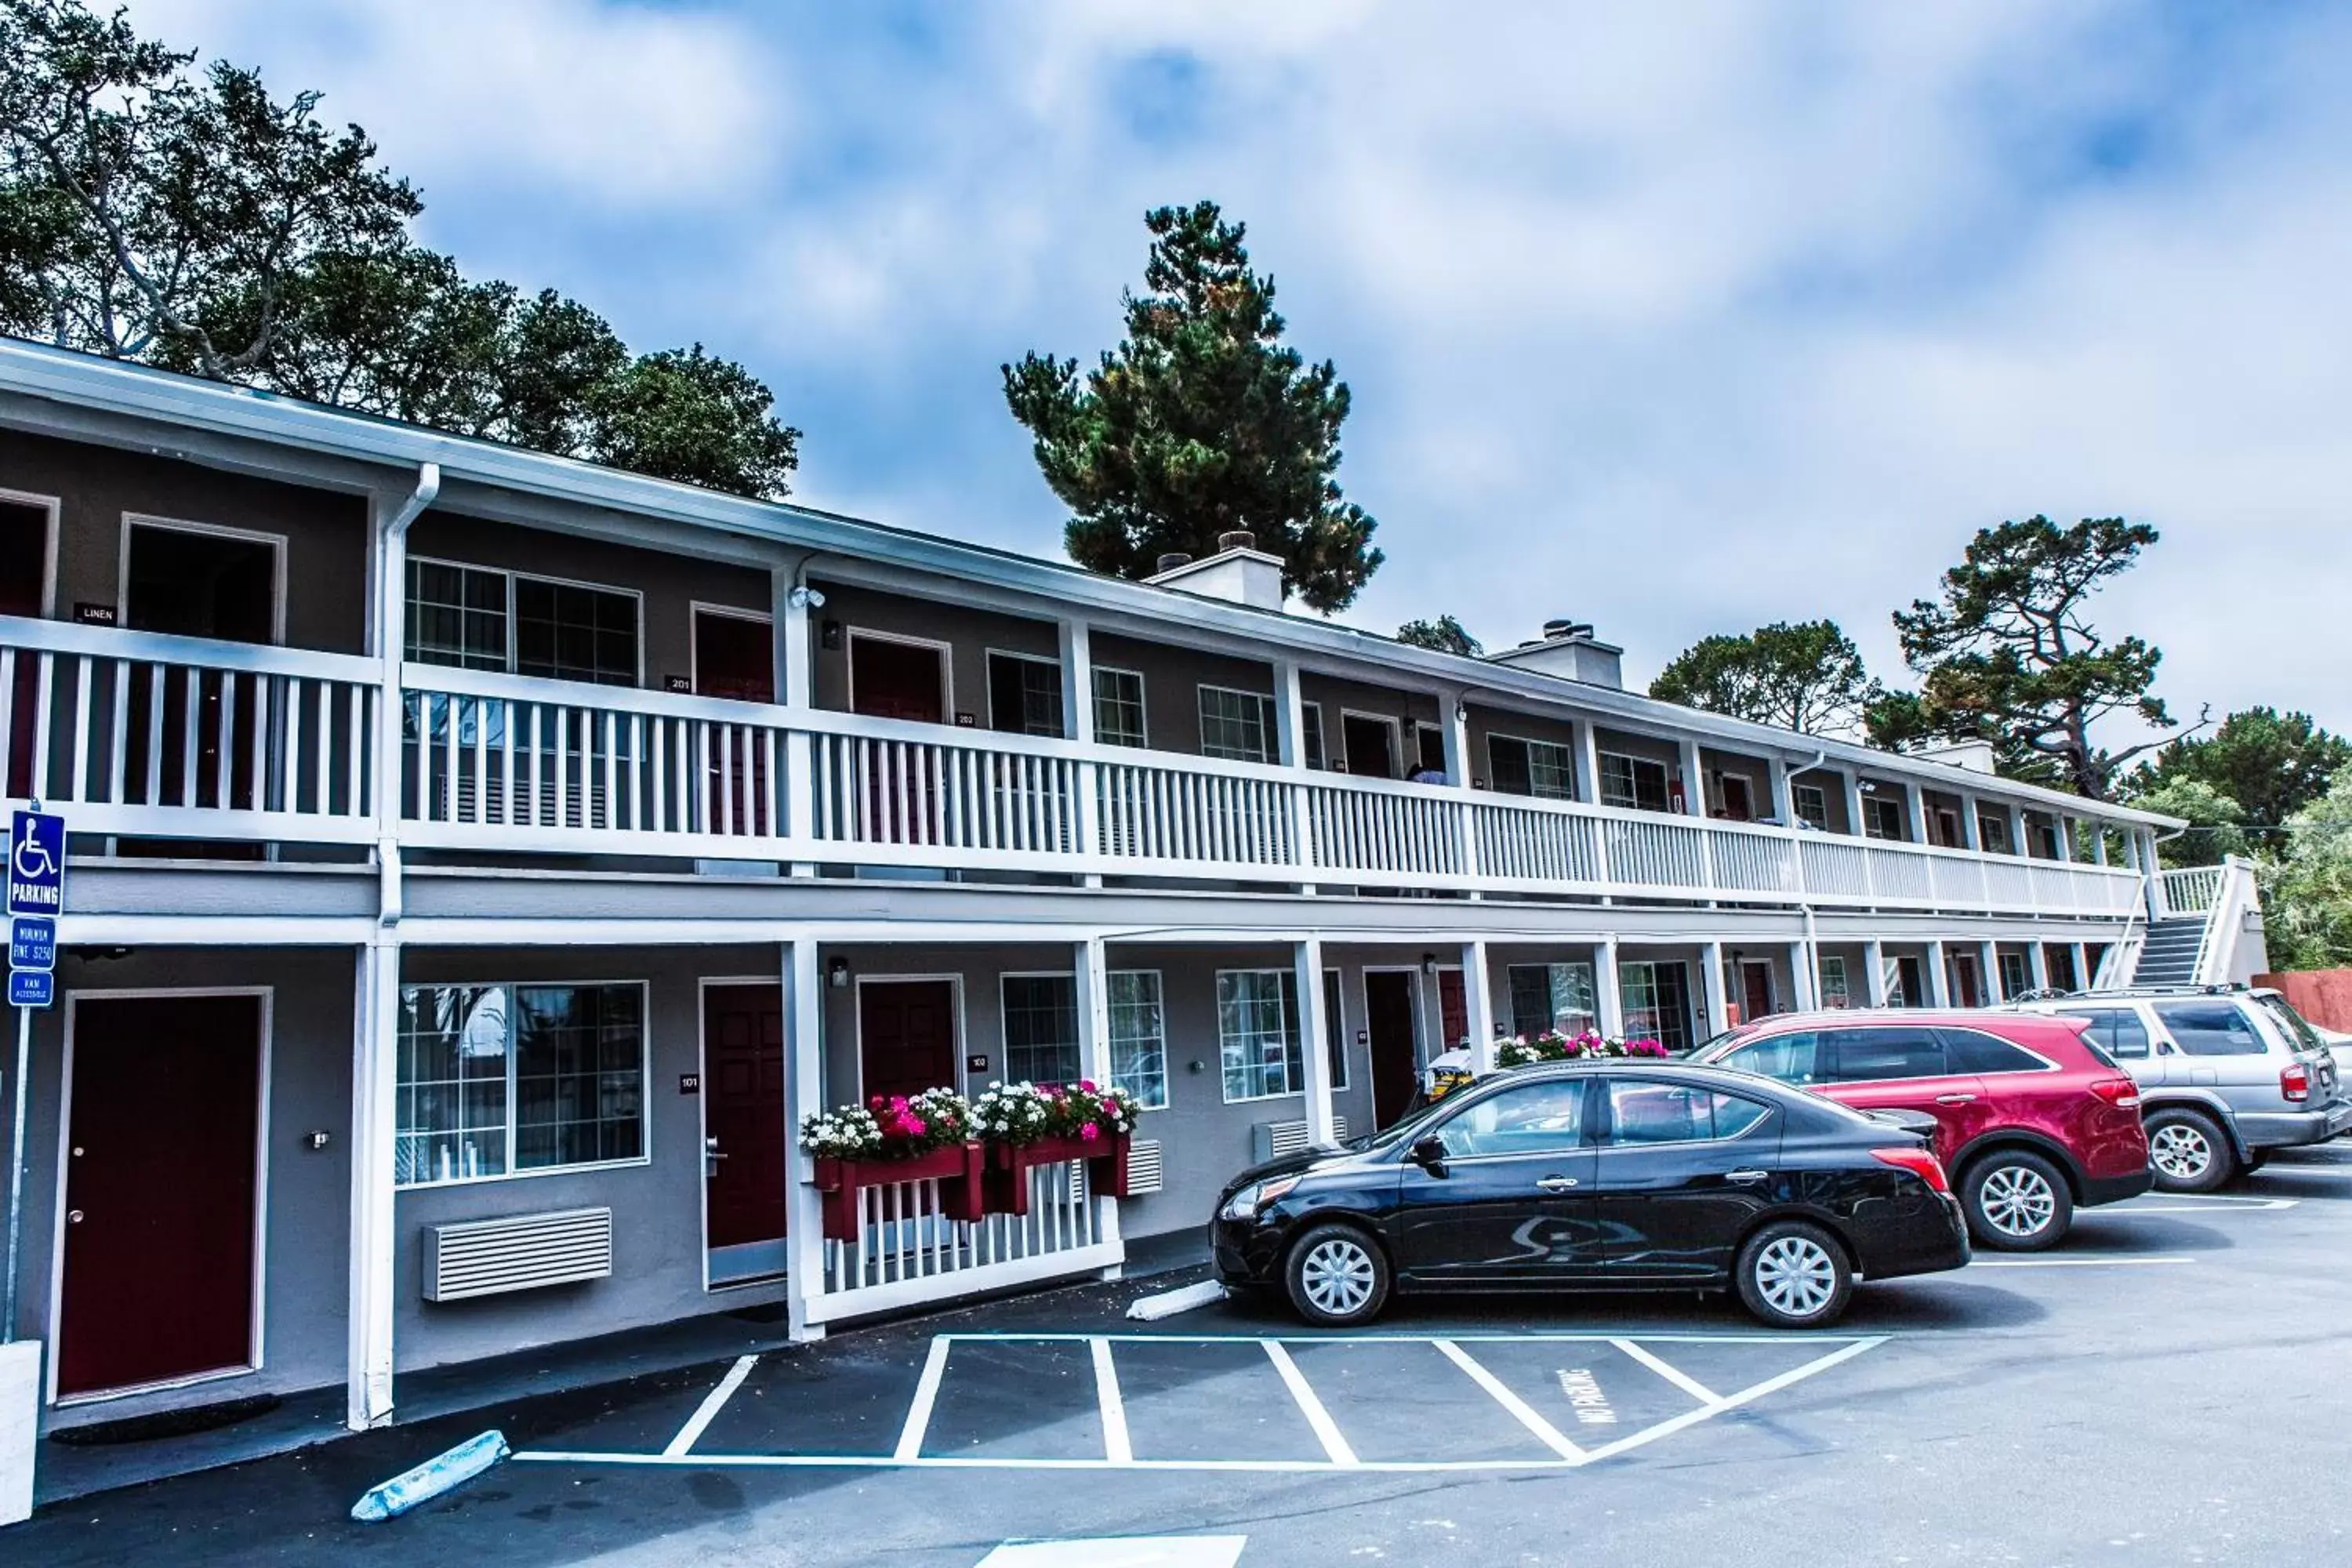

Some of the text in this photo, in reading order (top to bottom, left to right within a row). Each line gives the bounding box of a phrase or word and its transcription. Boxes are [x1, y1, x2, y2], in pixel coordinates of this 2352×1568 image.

[84, 608, 113, 620] LINEN
[672, 678, 689, 689] 201
[12, 882, 59, 906] PARKING
[13, 943, 52, 960] FINE $250
[24, 978, 40, 989] VAN
[682, 1078, 697, 1087] 101
[1575, 1409, 1619, 1423] NO
